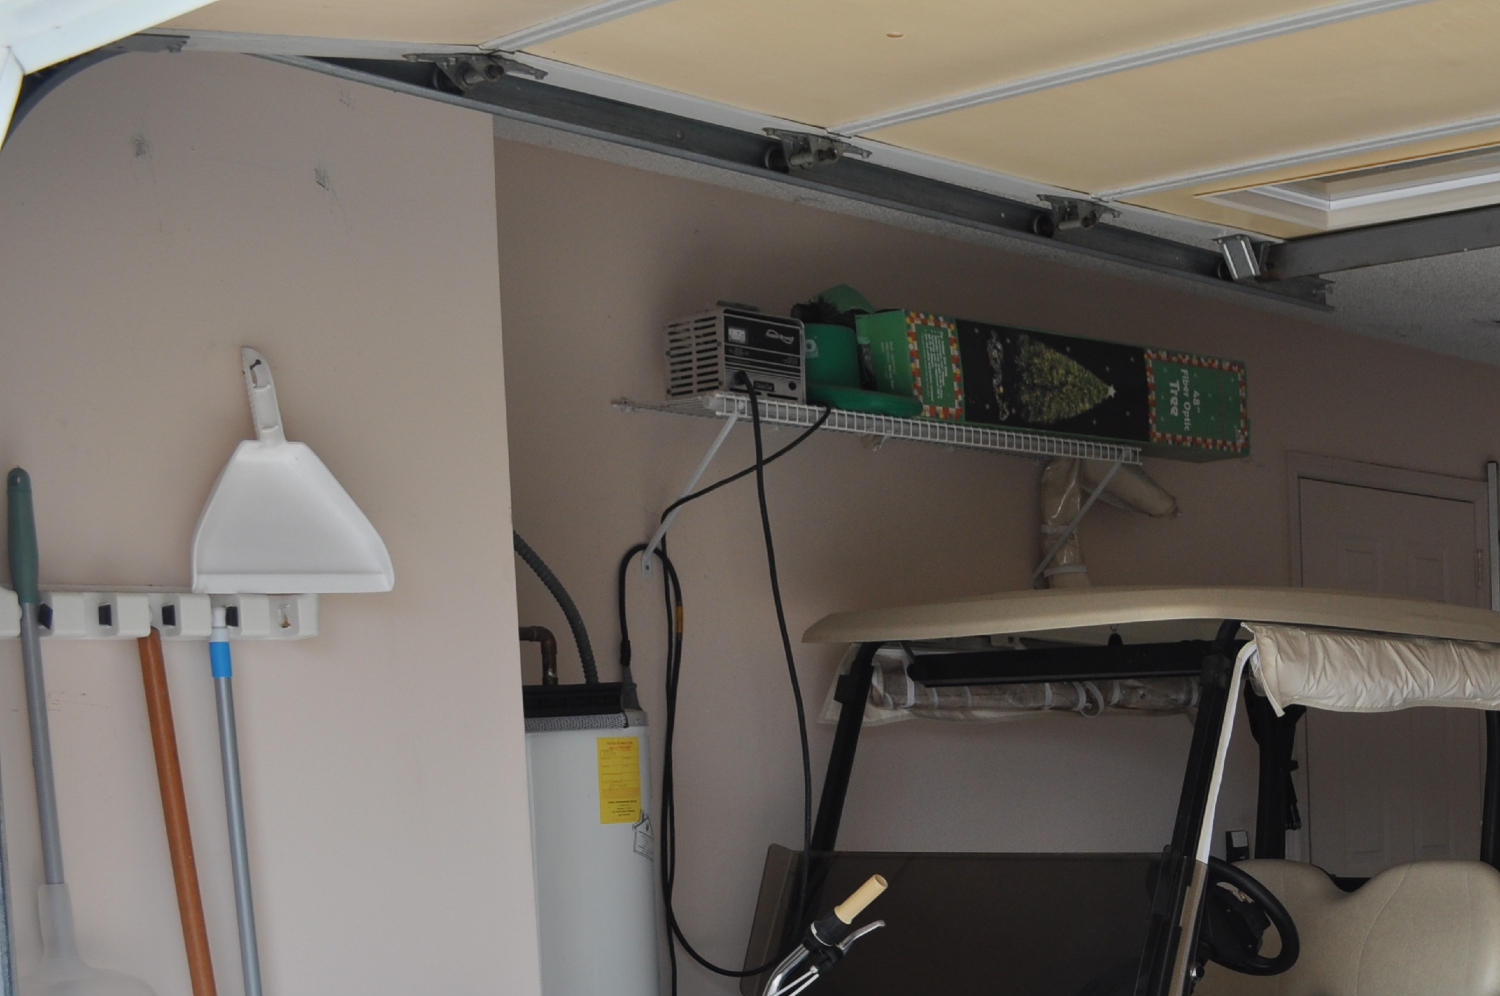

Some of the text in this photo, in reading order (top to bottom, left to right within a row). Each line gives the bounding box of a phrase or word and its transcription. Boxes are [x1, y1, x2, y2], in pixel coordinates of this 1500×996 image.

[1168, 379, 1180, 417] Tree
[1180, 368, 1192, 432] Fiber Optic
